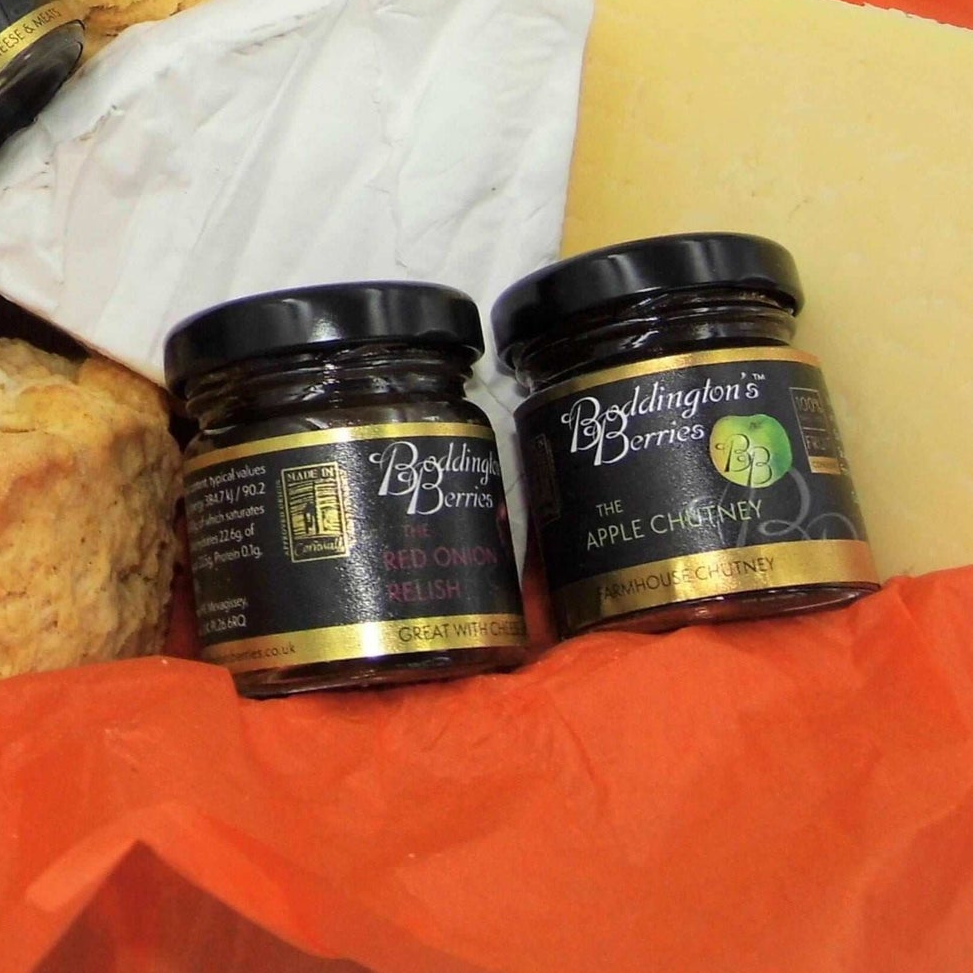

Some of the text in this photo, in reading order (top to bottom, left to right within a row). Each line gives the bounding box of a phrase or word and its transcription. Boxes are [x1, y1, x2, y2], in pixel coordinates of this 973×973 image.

[24, 24, 35, 36] &
[33, 7, 62, 28] MEATS
[561, 372, 760, 453] Boddington's
[585, 409, 705, 467] Berries
[236, 463, 267, 479] values
[287, 470, 319, 481] MADE
[242, 482, 266, 498] 90.2
[398, 460, 494, 515] Berries
[596, 499, 624, 518] THE
[245, 522, 256, 538] of
[586, 499, 763, 551] APPLE CHUTNEY
[383, 546, 498, 572] RED ONION
[596, 557, 775, 602] FARMHOUSE CHUTNEY
[387, 581, 461, 603] RELISH
[398, 623, 450, 643] GREAT
[453, 622, 488, 638] WITH
